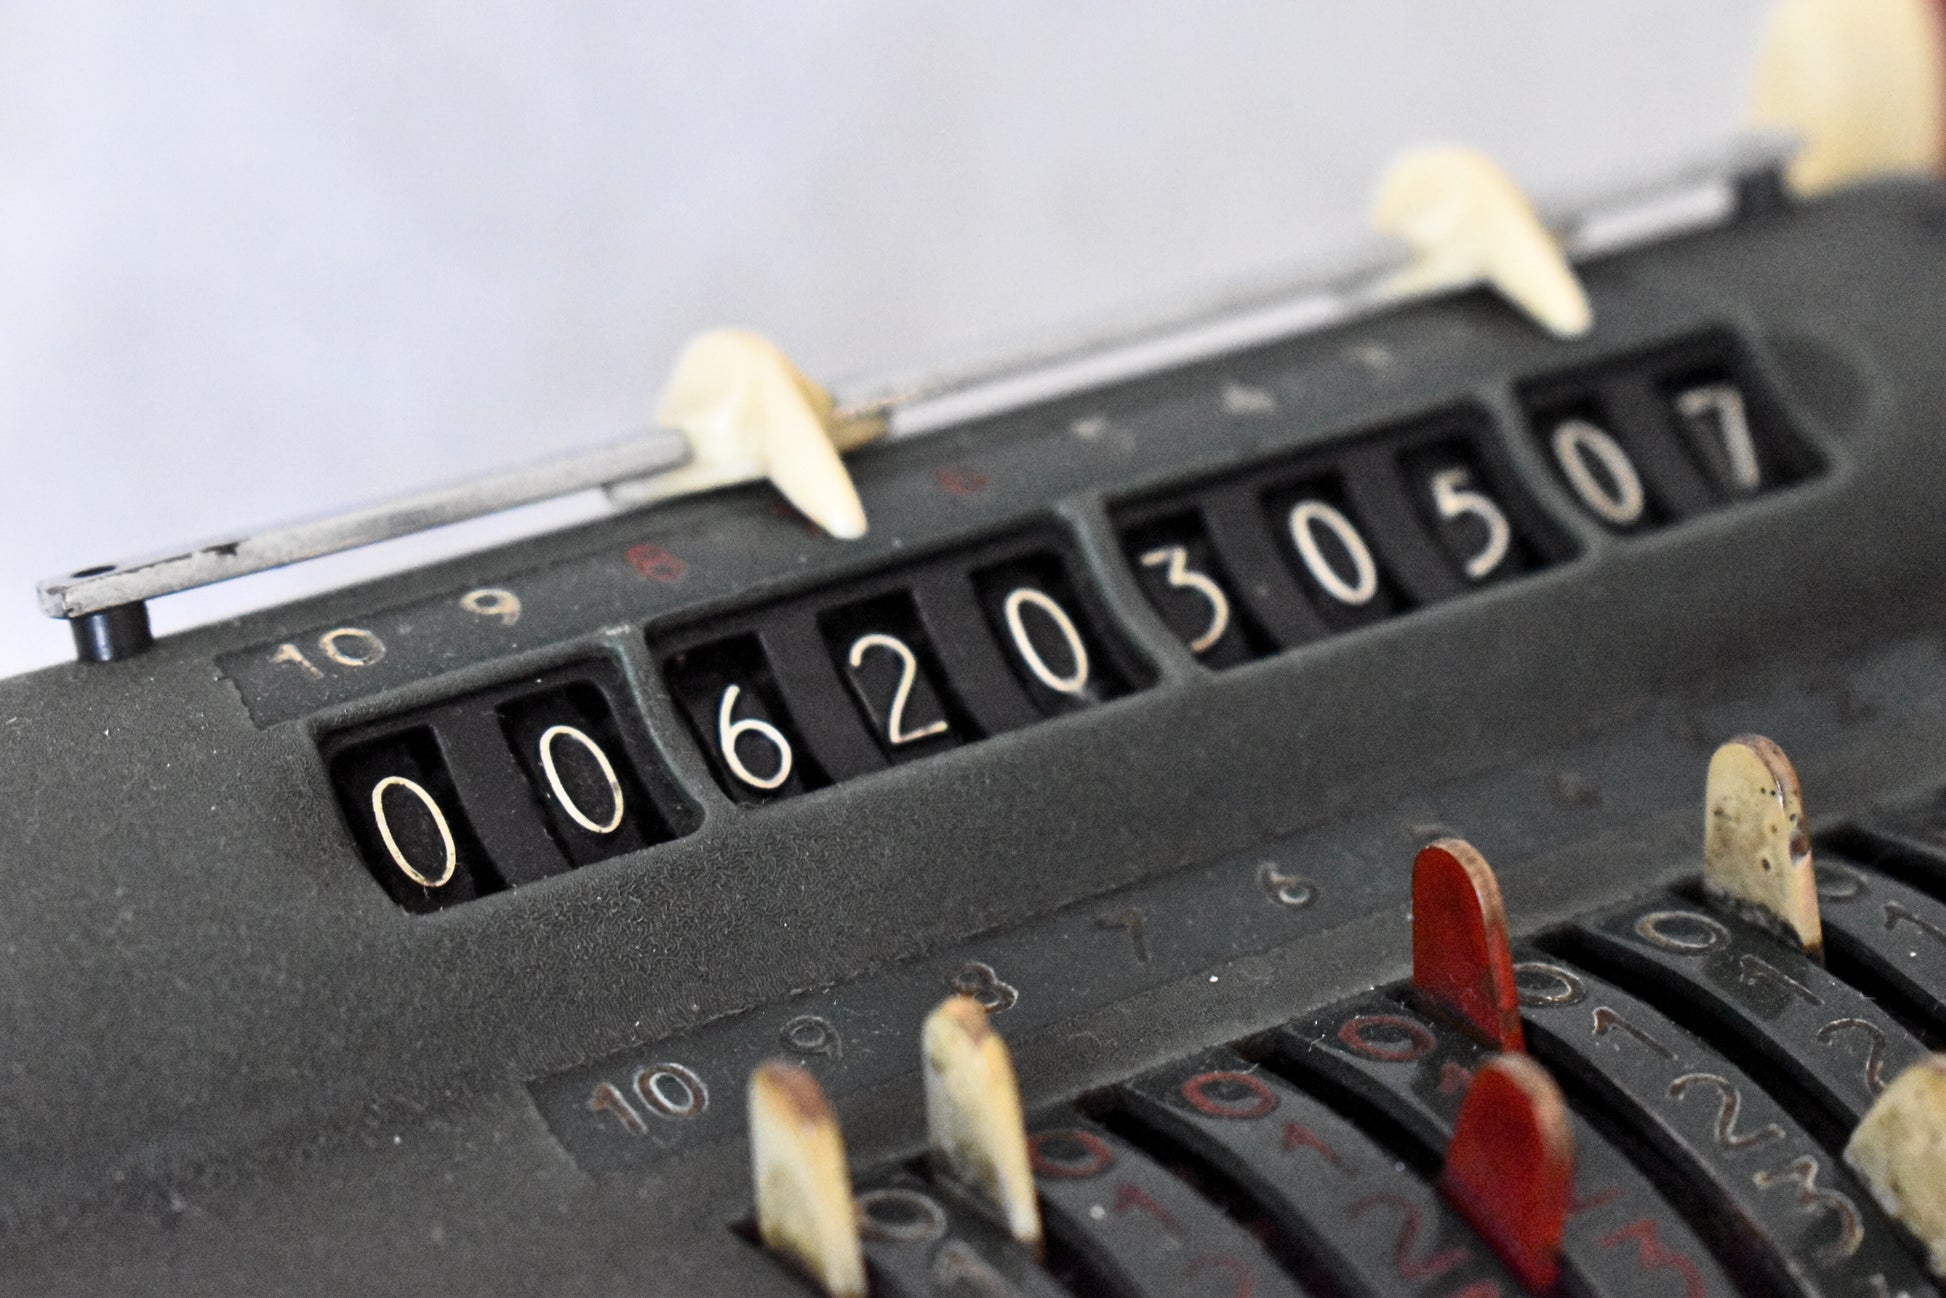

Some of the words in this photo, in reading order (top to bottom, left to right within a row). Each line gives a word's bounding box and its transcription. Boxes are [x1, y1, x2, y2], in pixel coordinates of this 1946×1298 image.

[270, 626, 387, 680] 10
[459, 587, 522, 627] 9
[371, 776, 456, 888] 0
[539, 724, 624, 834] 0
[718, 684, 793, 790] 6
[849, 633, 949, 744] 2
[1004, 586, 1089, 693] 0
[1139, 545, 1229, 653] 3
[1289, 500, 1378, 605] 0
[1430, 466, 1511, 579] 5
[1552, 418, 1645, 525] 0
[1676, 384, 1761, 489] 7
[591, 1061, 710, 1136] 10
[779, 1014, 842, 1061] 9
[1094, 908, 1151, 964] 7
[1256, 860, 1319, 910] 6
[1634, 909, 1732, 956] 0
[1739, 954, 1826, 1006] 1
[1337, 1014, 1437, 1062] 0
[1024, 1127, 1115, 1179] 0
[1182, 1070, 1279, 1119] 0
[1349, 1189, 1475, 1281] 2
[1592, 1005, 1680, 1061] 1
[1666, 1071, 1786, 1150] 2
[1752, 1154, 1866, 1270] 3
